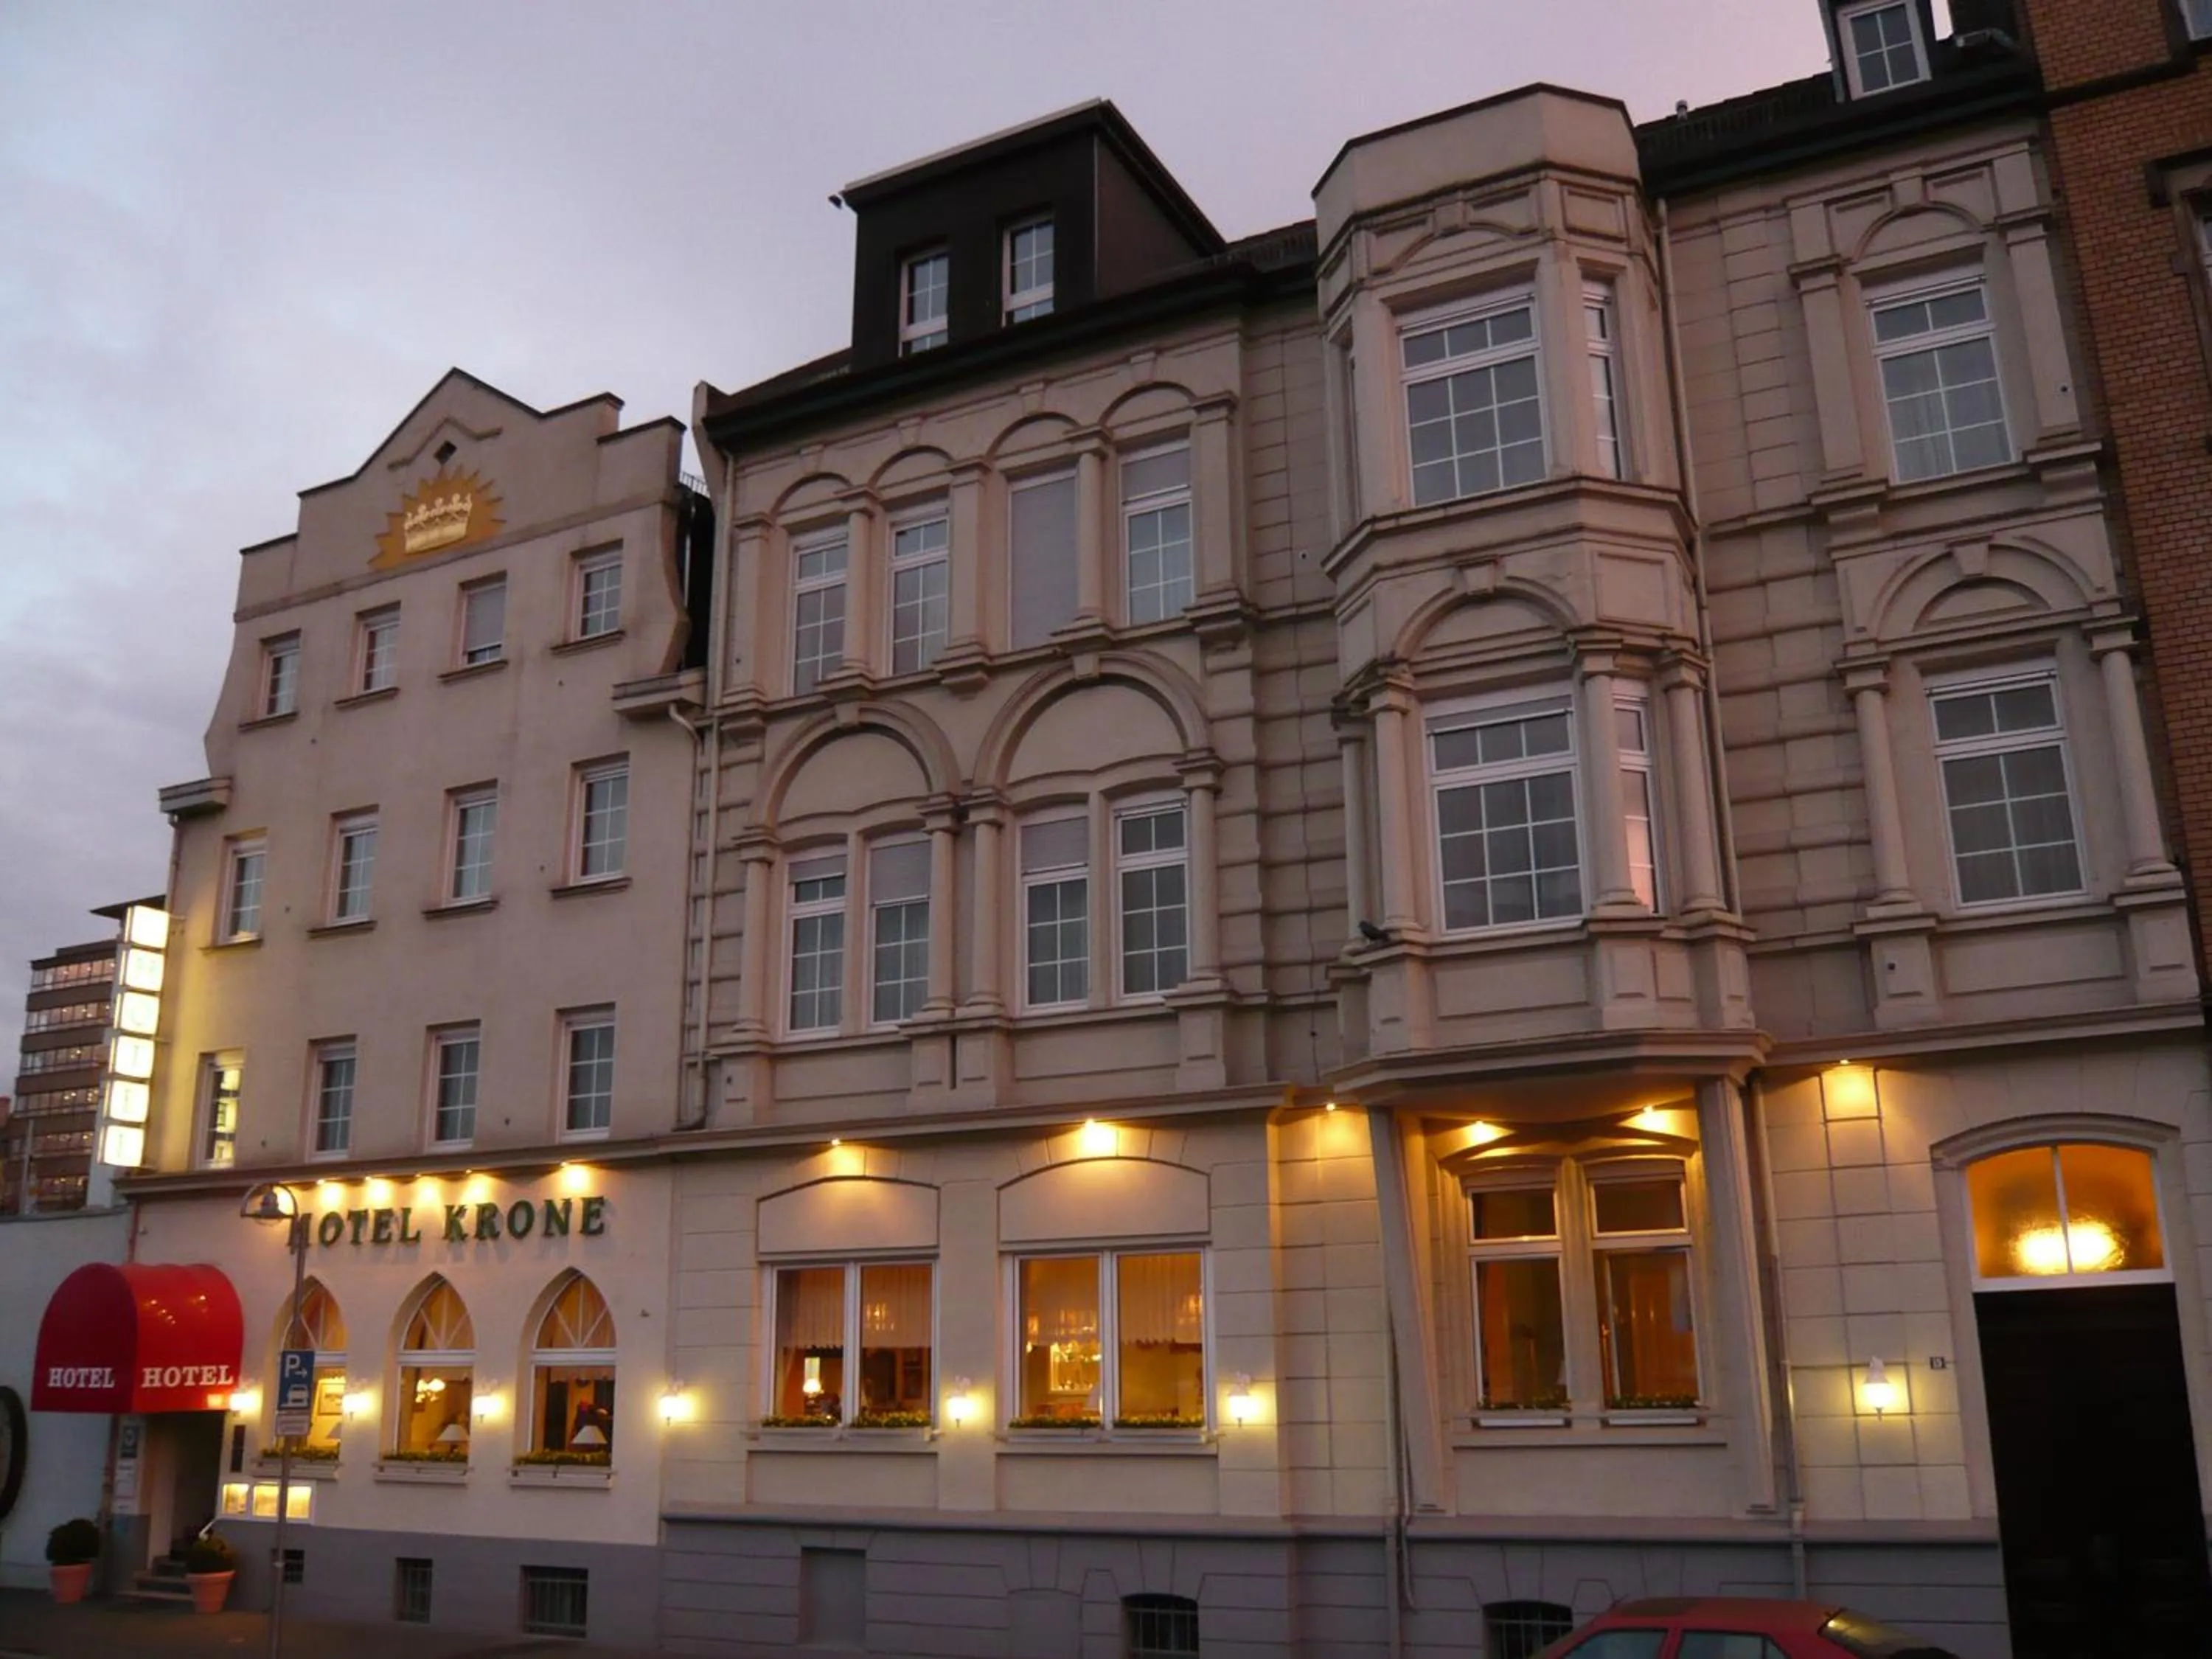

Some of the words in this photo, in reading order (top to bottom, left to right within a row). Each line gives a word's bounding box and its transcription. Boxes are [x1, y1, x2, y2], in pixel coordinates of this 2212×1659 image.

[442, 1196, 605, 1242] KRONE
[142, 1365, 234, 1388] HOTEL
[285, 1354, 301, 1377] P
[48, 1368, 116, 1388] HOTEL
